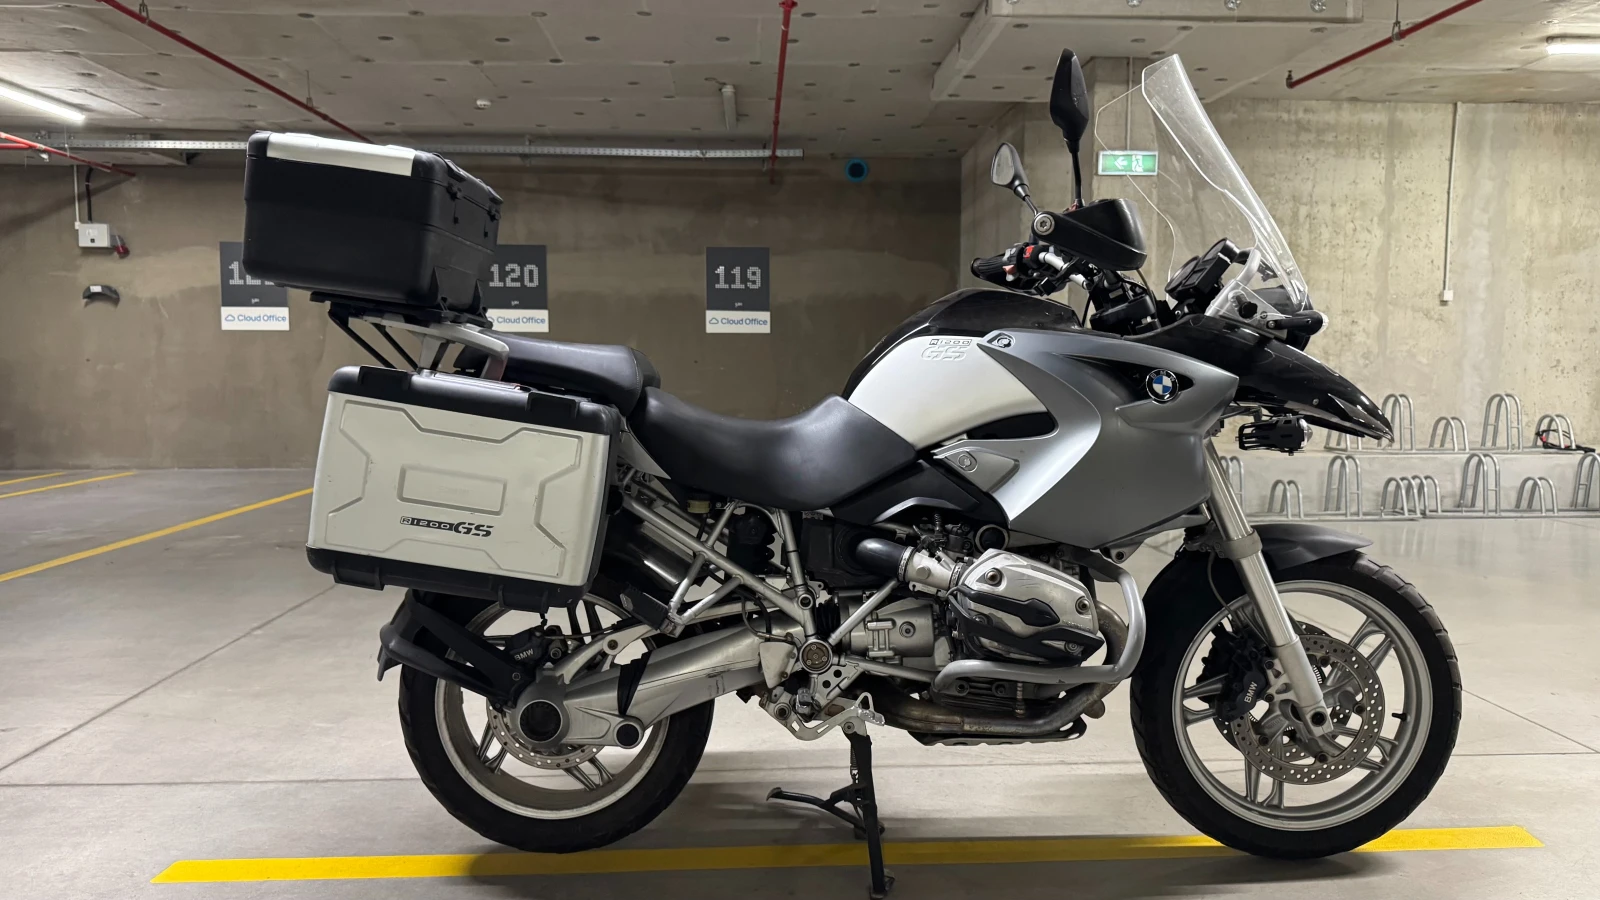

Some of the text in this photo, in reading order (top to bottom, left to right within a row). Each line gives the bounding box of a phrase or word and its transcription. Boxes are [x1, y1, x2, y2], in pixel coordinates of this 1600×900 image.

[489, 263, 539, 288] 120
[714, 266, 762, 289] 119
[237, 314, 287, 322] Cloud Office
[496, 316, 546, 325] Cloud Office
[720, 317, 768, 326] Cloud Office
[921, 346, 967, 361] GS
[514, 648, 534, 661] BMW
[1243, 681, 1258, 703] BMW
